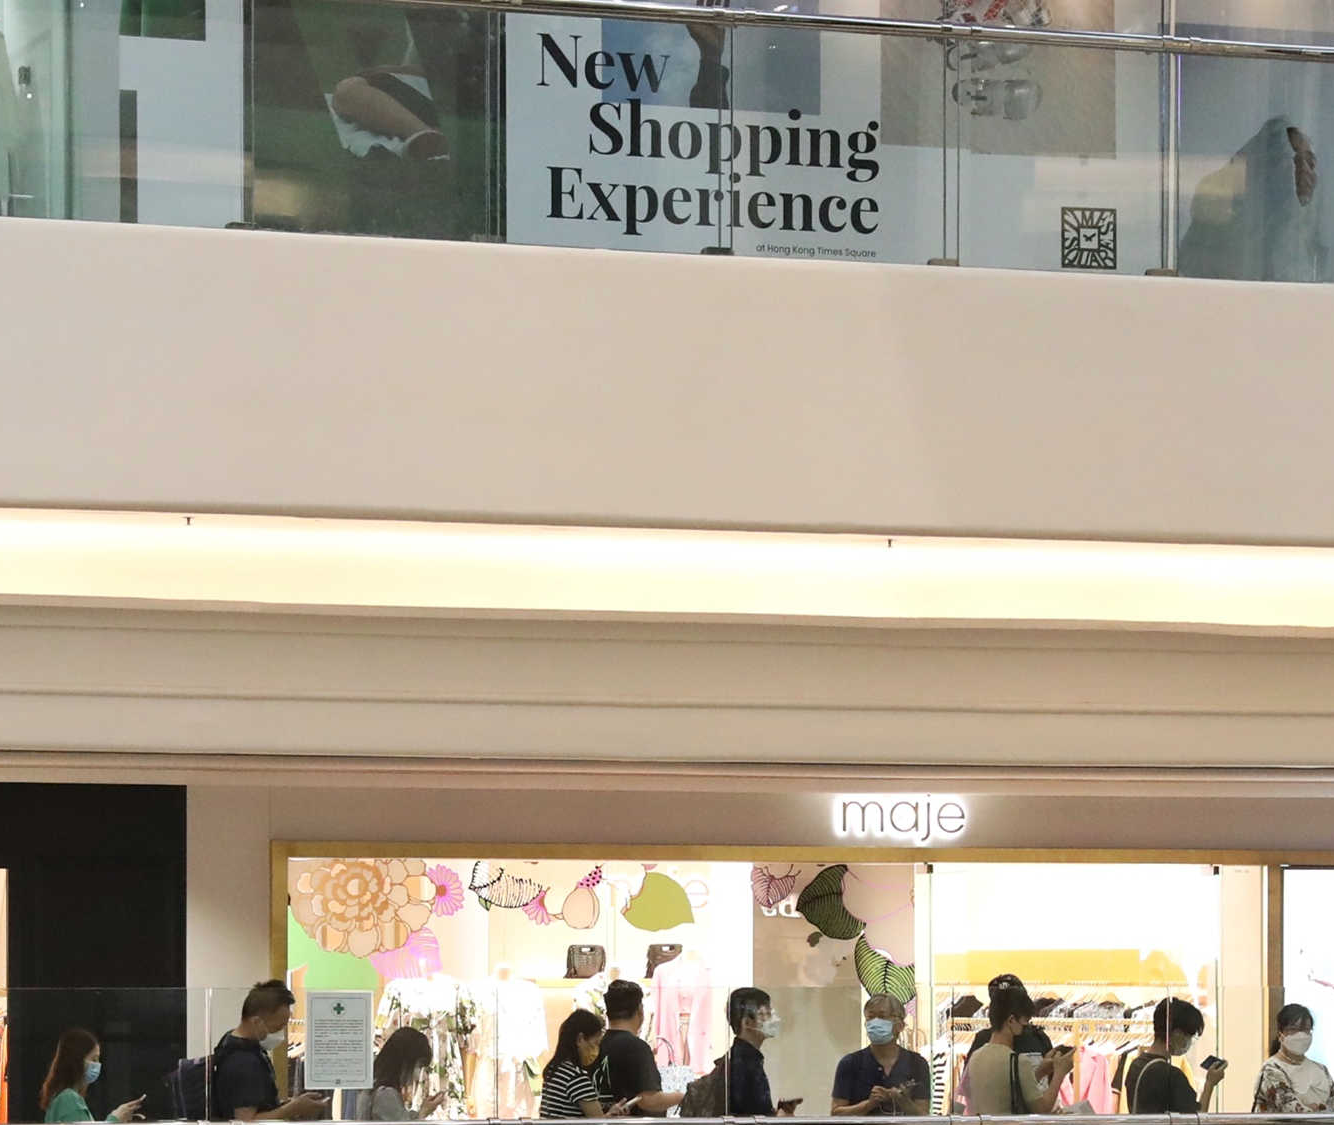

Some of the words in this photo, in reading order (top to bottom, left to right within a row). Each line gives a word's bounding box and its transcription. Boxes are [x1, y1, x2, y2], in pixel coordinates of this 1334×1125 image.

[536, 32, 670, 93] New
[589, 98, 880, 183] Shopping
[546, 166, 879, 236] Experience
[756, 244, 766, 252] at
[767, 245, 790, 256] Hong
[792, 246, 815, 257] Kong
[817, 247, 843, 256] Times
[845, 248, 876, 258] Square
[842, 793, 966, 841] maje
